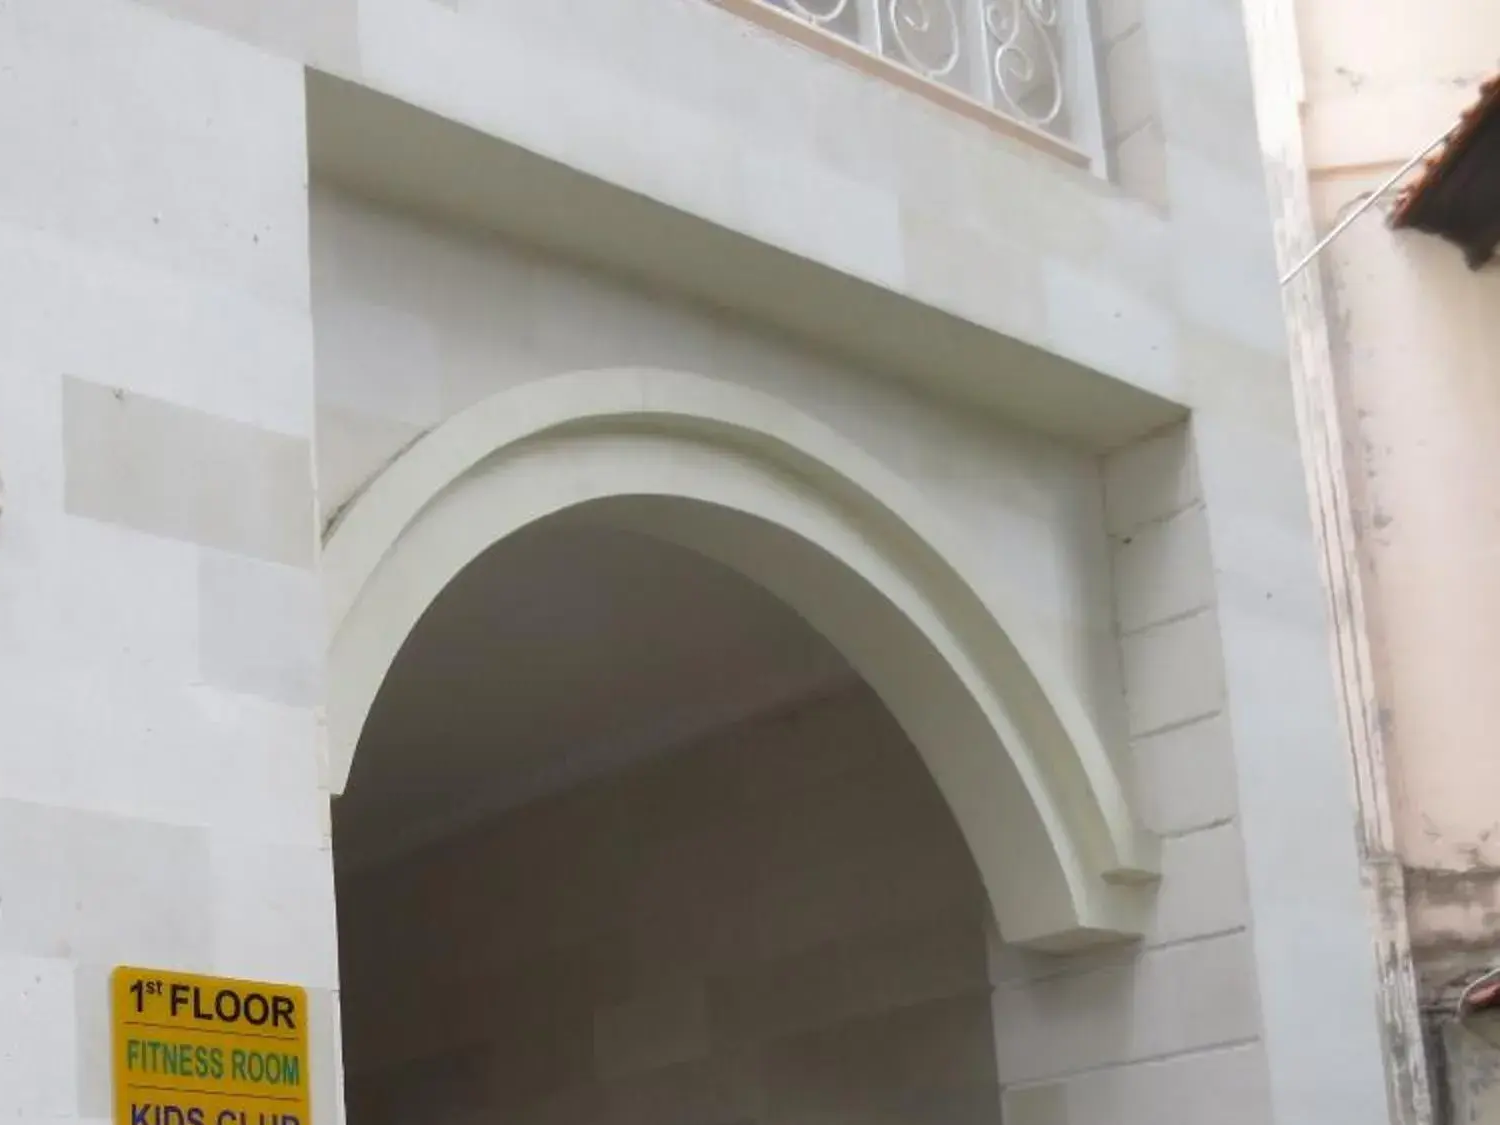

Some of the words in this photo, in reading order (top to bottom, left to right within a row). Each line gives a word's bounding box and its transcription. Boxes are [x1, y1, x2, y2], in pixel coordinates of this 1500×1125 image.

[129, 979, 163, 1013] 1st
[171, 985, 295, 1028] FLOOR
[127, 1040, 224, 1079] FITNESS
[232, 1050, 299, 1085] ROOM
